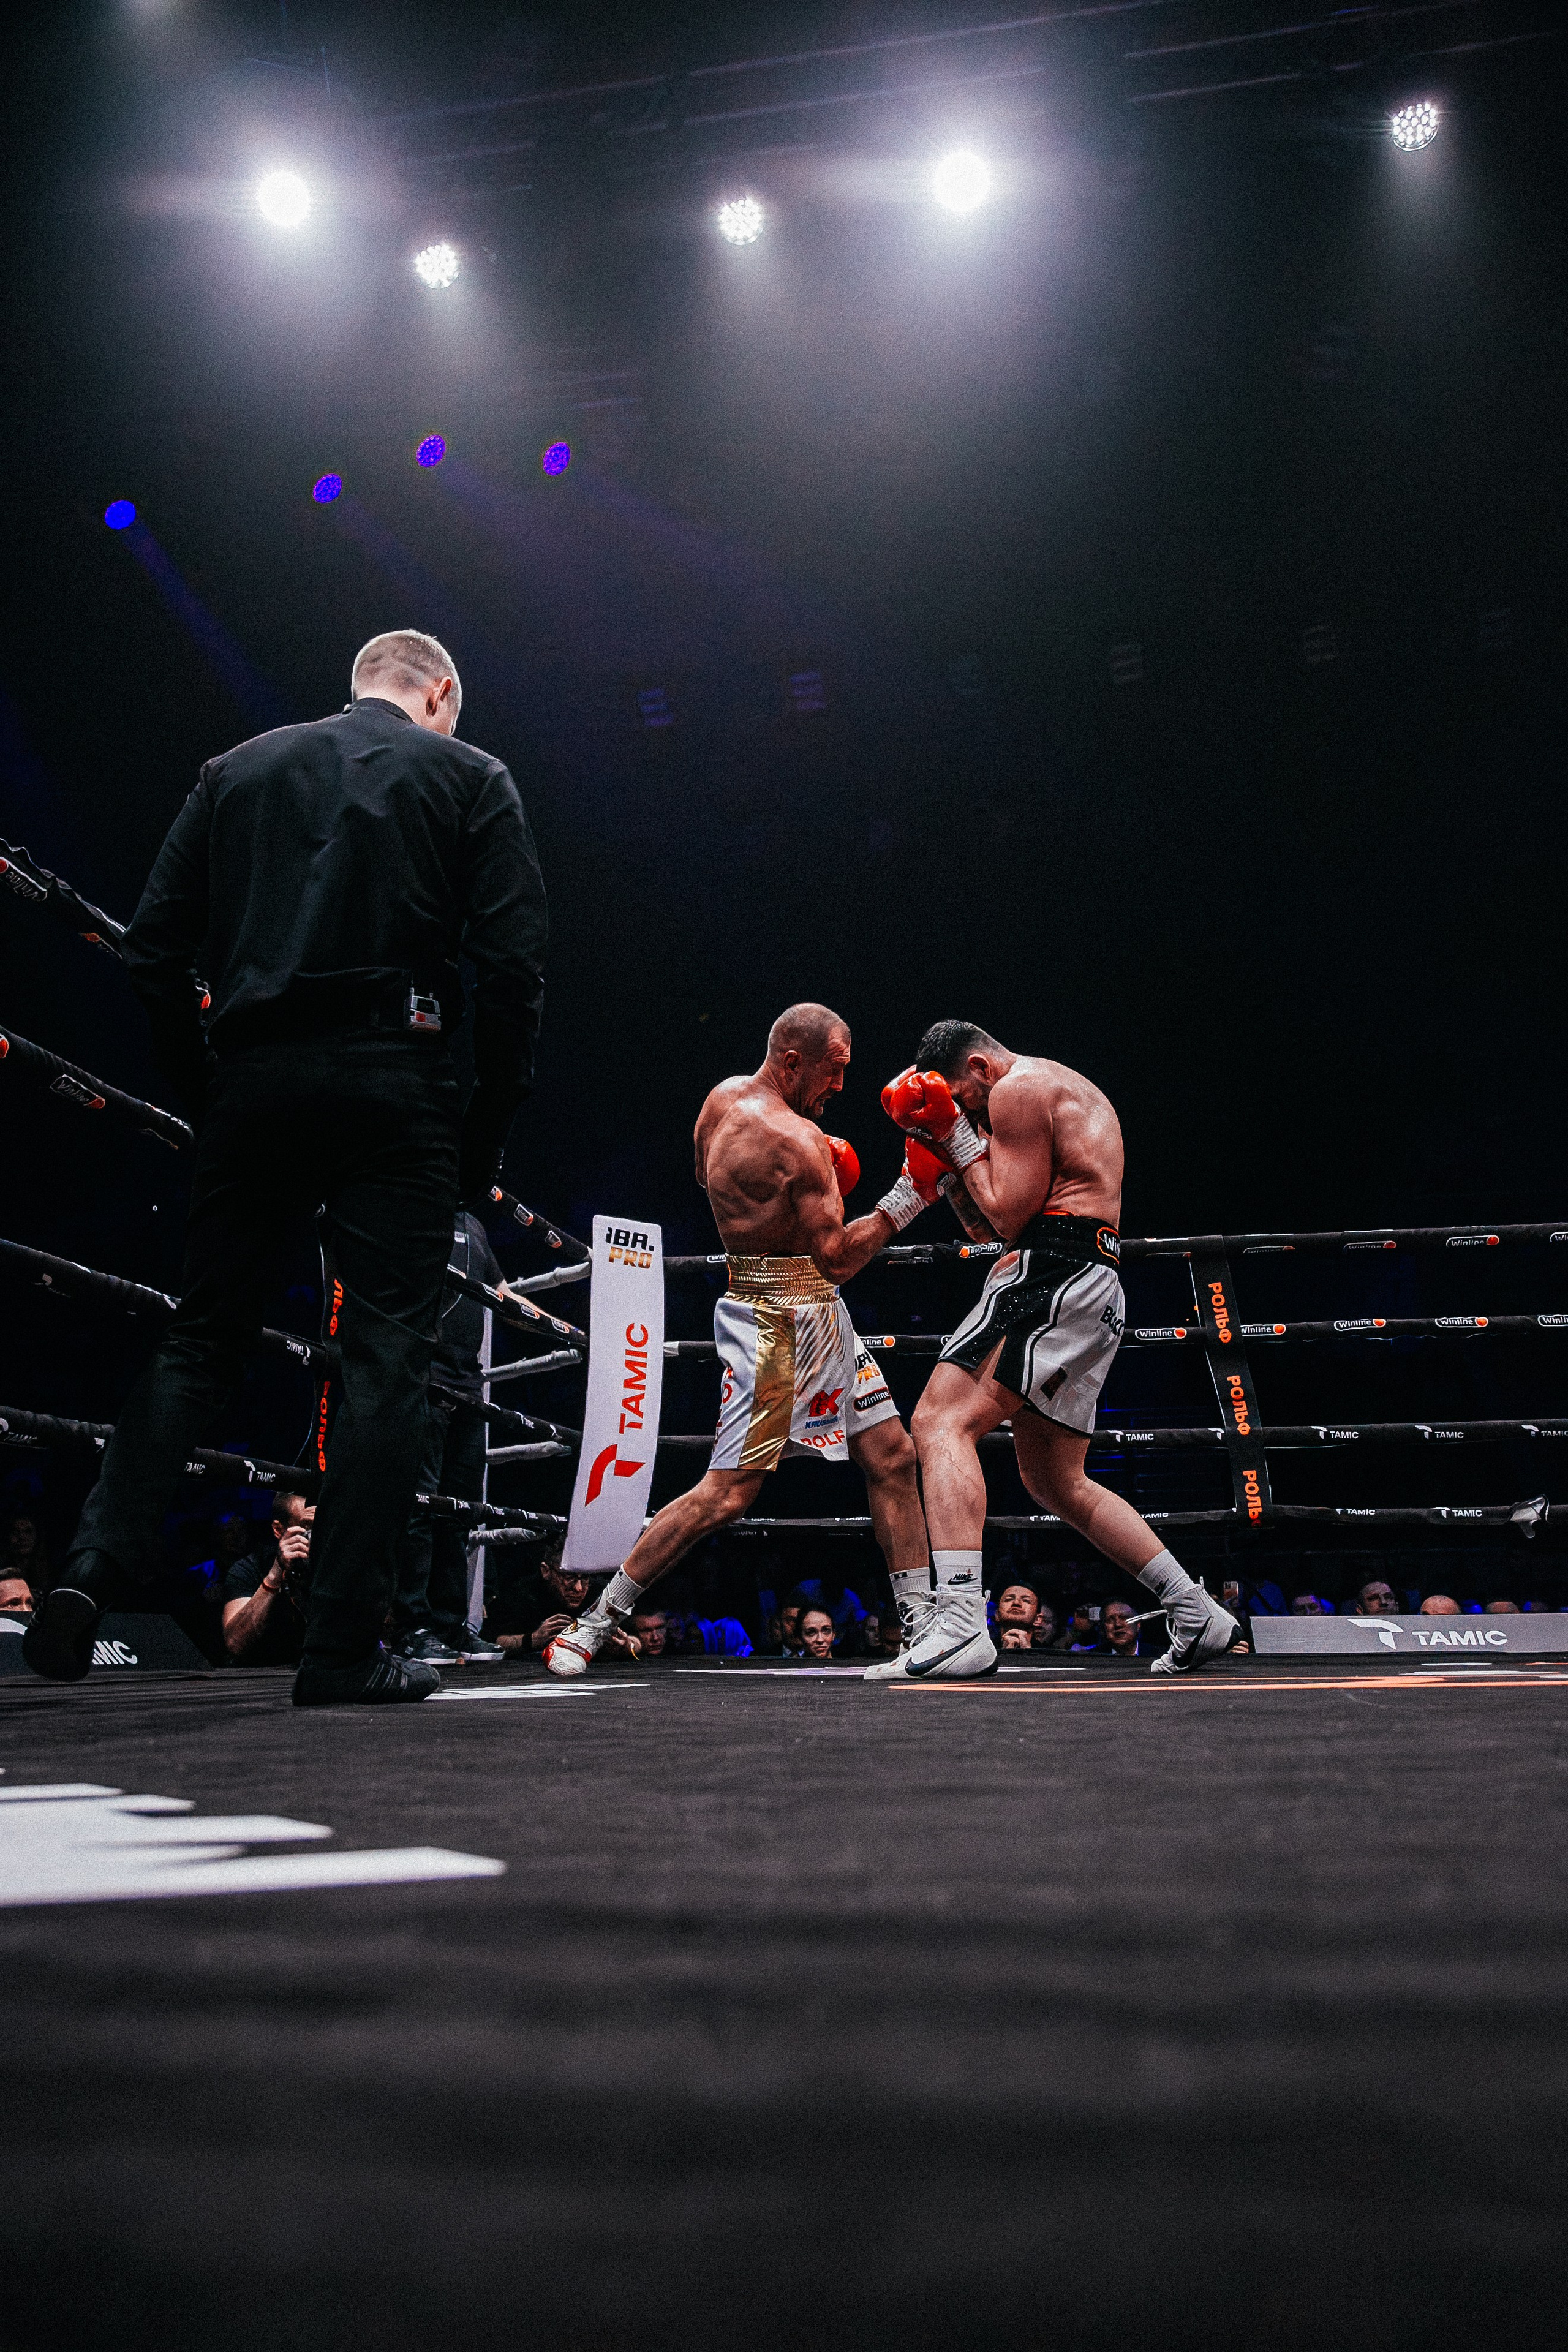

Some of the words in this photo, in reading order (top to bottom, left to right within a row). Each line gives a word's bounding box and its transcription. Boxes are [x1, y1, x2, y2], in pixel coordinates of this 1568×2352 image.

[608, 1246, 652, 1269] PRO
[330, 1278, 344, 1336] ЛЬФ
[1208, 1282, 1232, 1343] РОЛЬФ
[1339, 1319, 1371, 1328] Winline
[619, 1322, 649, 1434] TAMIC
[858, 1391, 889, 1408] Winline
[1227, 1375, 1251, 1435] РОЛЬФ
[1411, 1630, 1508, 1645] TAMIC
[92, 1641, 138, 1665] MIC
